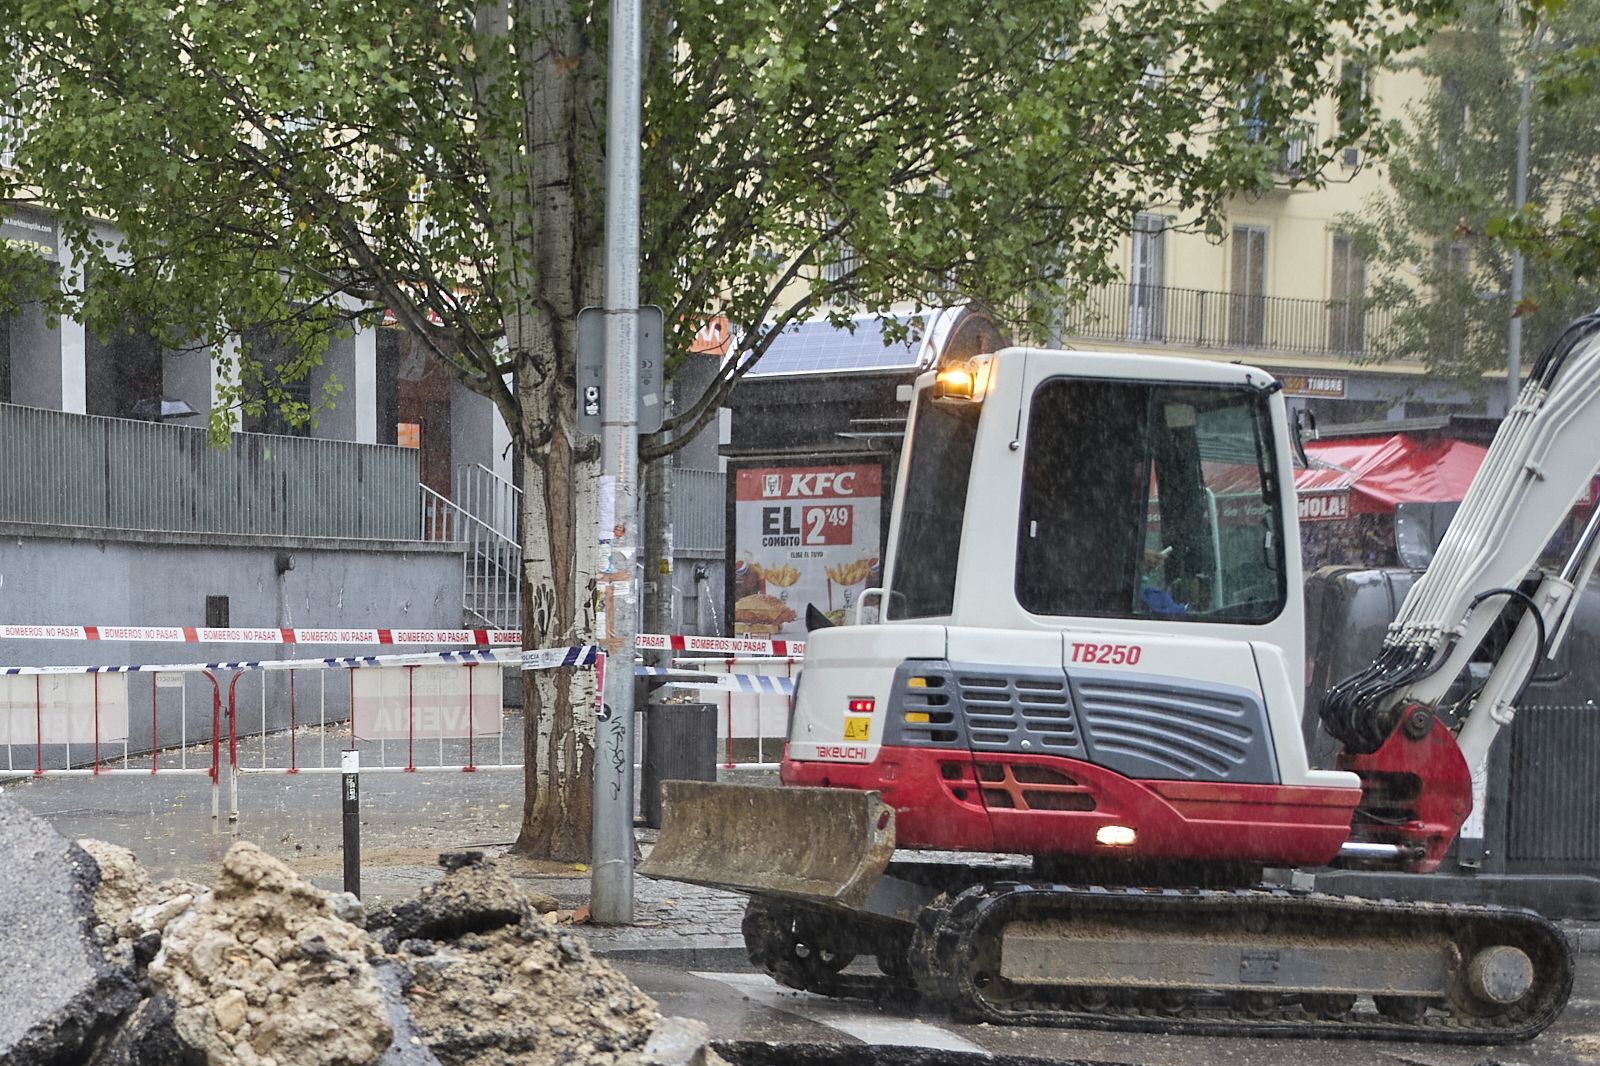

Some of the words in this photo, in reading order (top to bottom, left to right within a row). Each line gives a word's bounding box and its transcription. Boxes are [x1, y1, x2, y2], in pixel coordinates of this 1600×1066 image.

[1307, 376, 1343, 391] TIMBRE
[787, 472, 856, 496] KFC
[762, 507, 800, 535] EL
[762, 536, 800, 547] COMBITO
[5, 627, 43, 636] BOMBEROS
[46, 628, 55, 637] NO
[57, 629, 79, 638] PASAR
[105, 629, 142, 638] BOMBEROS
[145, 629, 154, 639] NO
[156, 630, 178, 639] PASAR
[204, 630, 240, 640] BOMBEROS
[243, 631, 252, 640] NO
[253, 631, 276, 640] PASAR
[301, 631, 337, 641] BOMBEROS
[340, 632, 350, 641] NO
[350, 632, 373, 641] PASAR
[398, 632, 434, 642] BOMBEROS
[437, 633, 446, 642] NO
[447, 633, 469, 642] PASAR
[494, 632, 522, 643] BOMBER
[642, 637, 665, 647] PASAR
[691, 639, 729, 650] BOMBEROS
[732, 640, 742, 650] NO
[743, 641, 767, 652] PASAR
[1071, 642, 1142, 665] TB250
